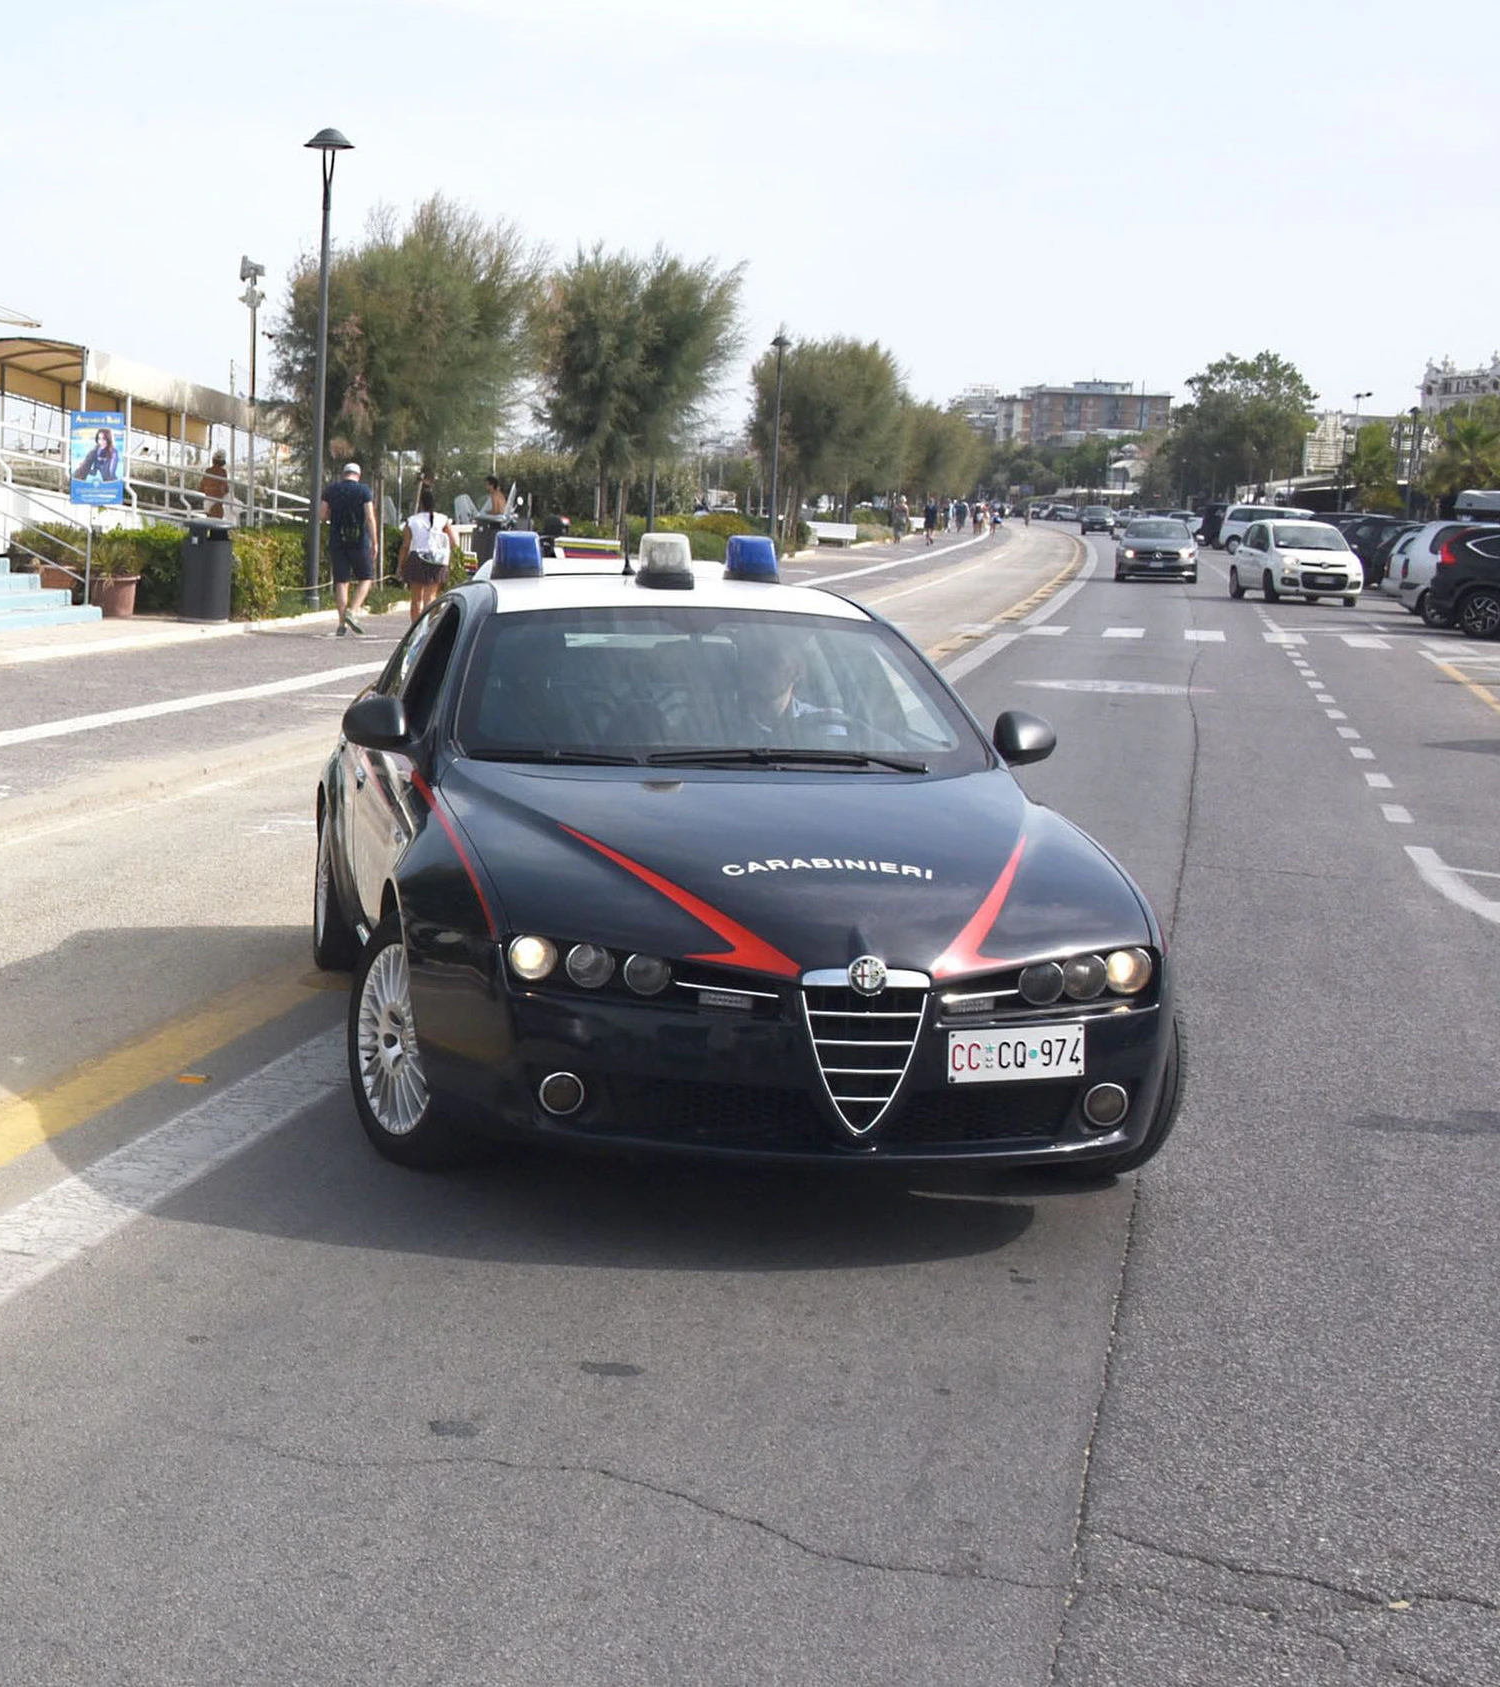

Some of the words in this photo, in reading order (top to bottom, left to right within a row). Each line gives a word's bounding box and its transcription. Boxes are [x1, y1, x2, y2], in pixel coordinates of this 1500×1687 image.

[722, 858, 933, 880] CARABINIERI
[952, 1043, 981, 1071] CC
[998, 1041, 1026, 1069] CQ
[1041, 1038, 1081, 1067] 974
